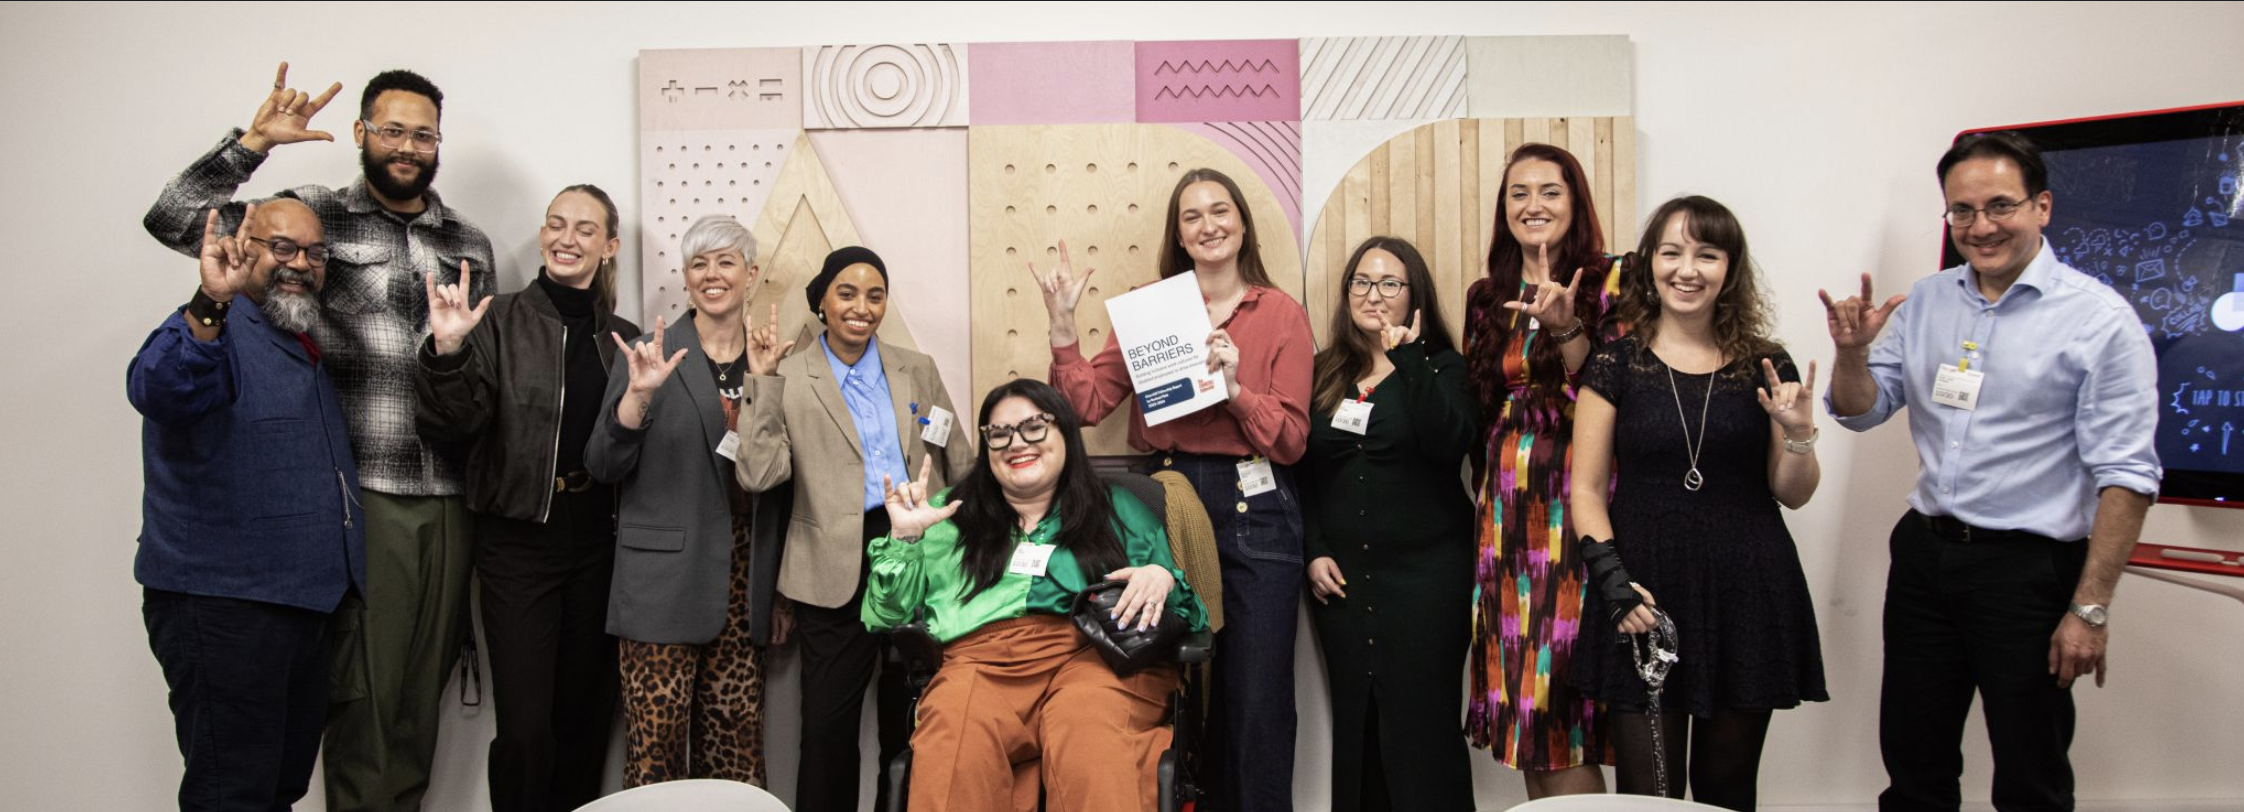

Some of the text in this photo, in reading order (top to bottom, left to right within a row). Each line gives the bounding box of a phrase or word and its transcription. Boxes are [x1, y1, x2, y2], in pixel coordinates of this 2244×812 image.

[1128, 335, 1179, 359] BEYOND
[1132, 343, 1194, 371] BARRIERS
[2192, 390, 2213, 406] TAP
[2217, 390, 2230, 406] TO
